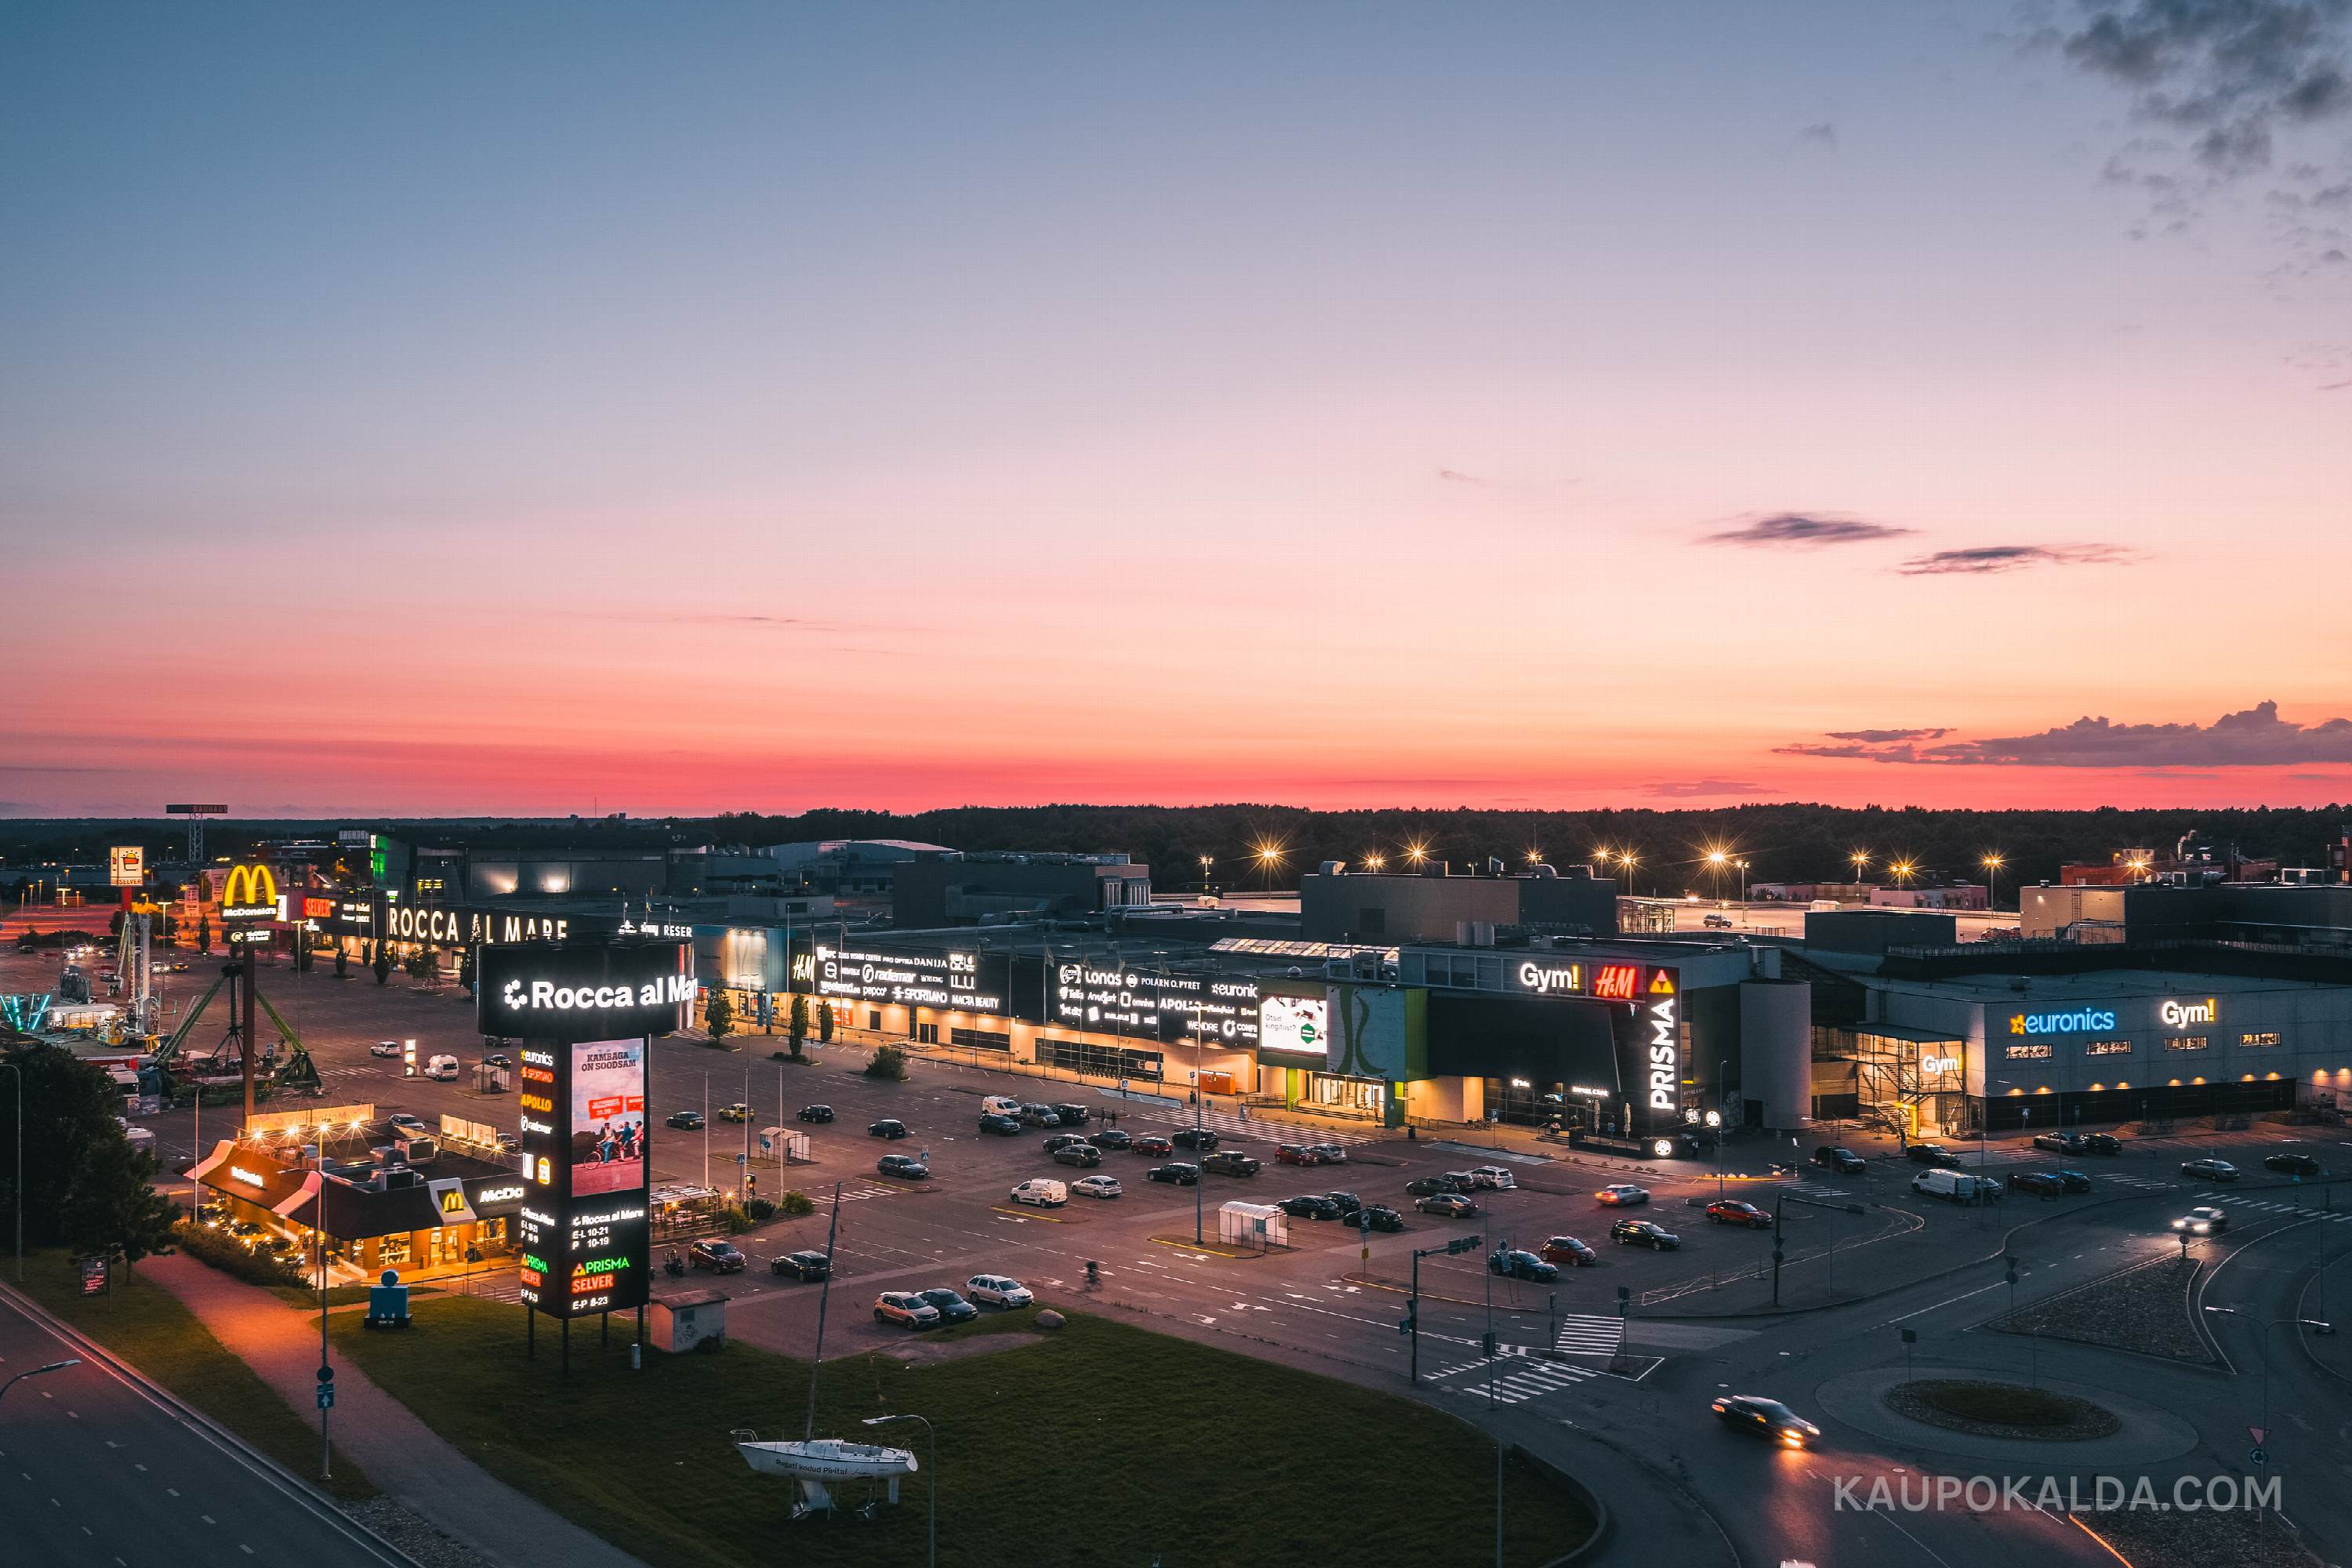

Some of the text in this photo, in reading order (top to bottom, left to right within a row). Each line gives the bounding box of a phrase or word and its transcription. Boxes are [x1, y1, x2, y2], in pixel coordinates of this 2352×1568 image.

[305, 898, 331, 916] SELVER
[389, 907, 459, 942] ROCCA
[664, 924, 692, 938] RESER
[793, 953, 816, 982] H&M
[913, 958, 948, 968] DANIJA
[874, 968, 916, 984] rademar
[1141, 977, 1170, 988] POLARN
[1519, 963, 1579, 993] Gym!
[1595, 965, 1637, 1000] H&M
[532, 980, 634, 1010] Rocca
[640, 977, 663, 1005] al
[905, 988, 948, 1004] SPORTLAND
[975, 996, 1000, 1010] BEAUTY
[2025, 1007, 2115, 1034] euronics
[2161, 997, 2216, 1029] Gym!
[1187, 1020, 1219, 1033] WENDRE
[524, 1051, 554, 1066] euronics
[587, 1051, 630, 1062] KAMBAGA
[1650, 998, 1675, 1111] PRISMA
[581, 1059, 637, 1072] ON SOODSAM
[1922, 1054, 1964, 1076] Gym!
[521, 1094, 553, 1112] APOLLO
[581, 1210, 644, 1226] Rocca al Mare
[572, 1226, 609, 1240] E-L 10-21
[572, 1236, 610, 1250] P 10-19
[527, 1254, 548, 1273] PRISMA
[585, 1257, 631, 1274] PRISMA
[521, 1270, 542, 1287] SELVER
[572, 1274, 615, 1294] SELVER
[572, 1296, 608, 1311] E-P 8-23
[799, 1464, 822, 1473] kodud
